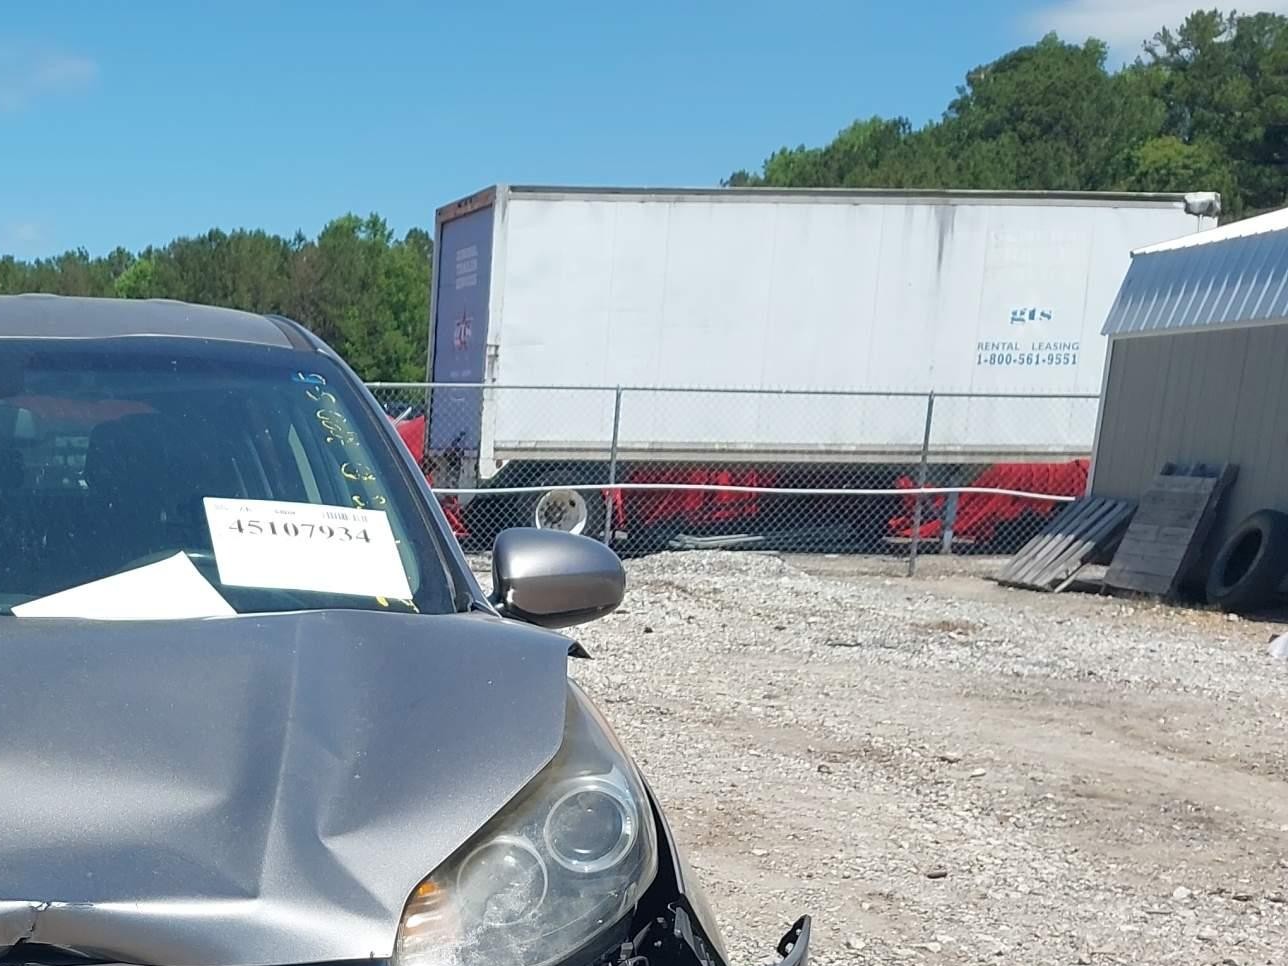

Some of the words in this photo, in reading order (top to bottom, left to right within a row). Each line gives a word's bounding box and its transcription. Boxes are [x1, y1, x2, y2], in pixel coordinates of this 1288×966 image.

[977, 342, 1020, 351] RENTAL
[1032, 342, 1080, 351] LEASING
[228, 519, 371, 544] 45107934
